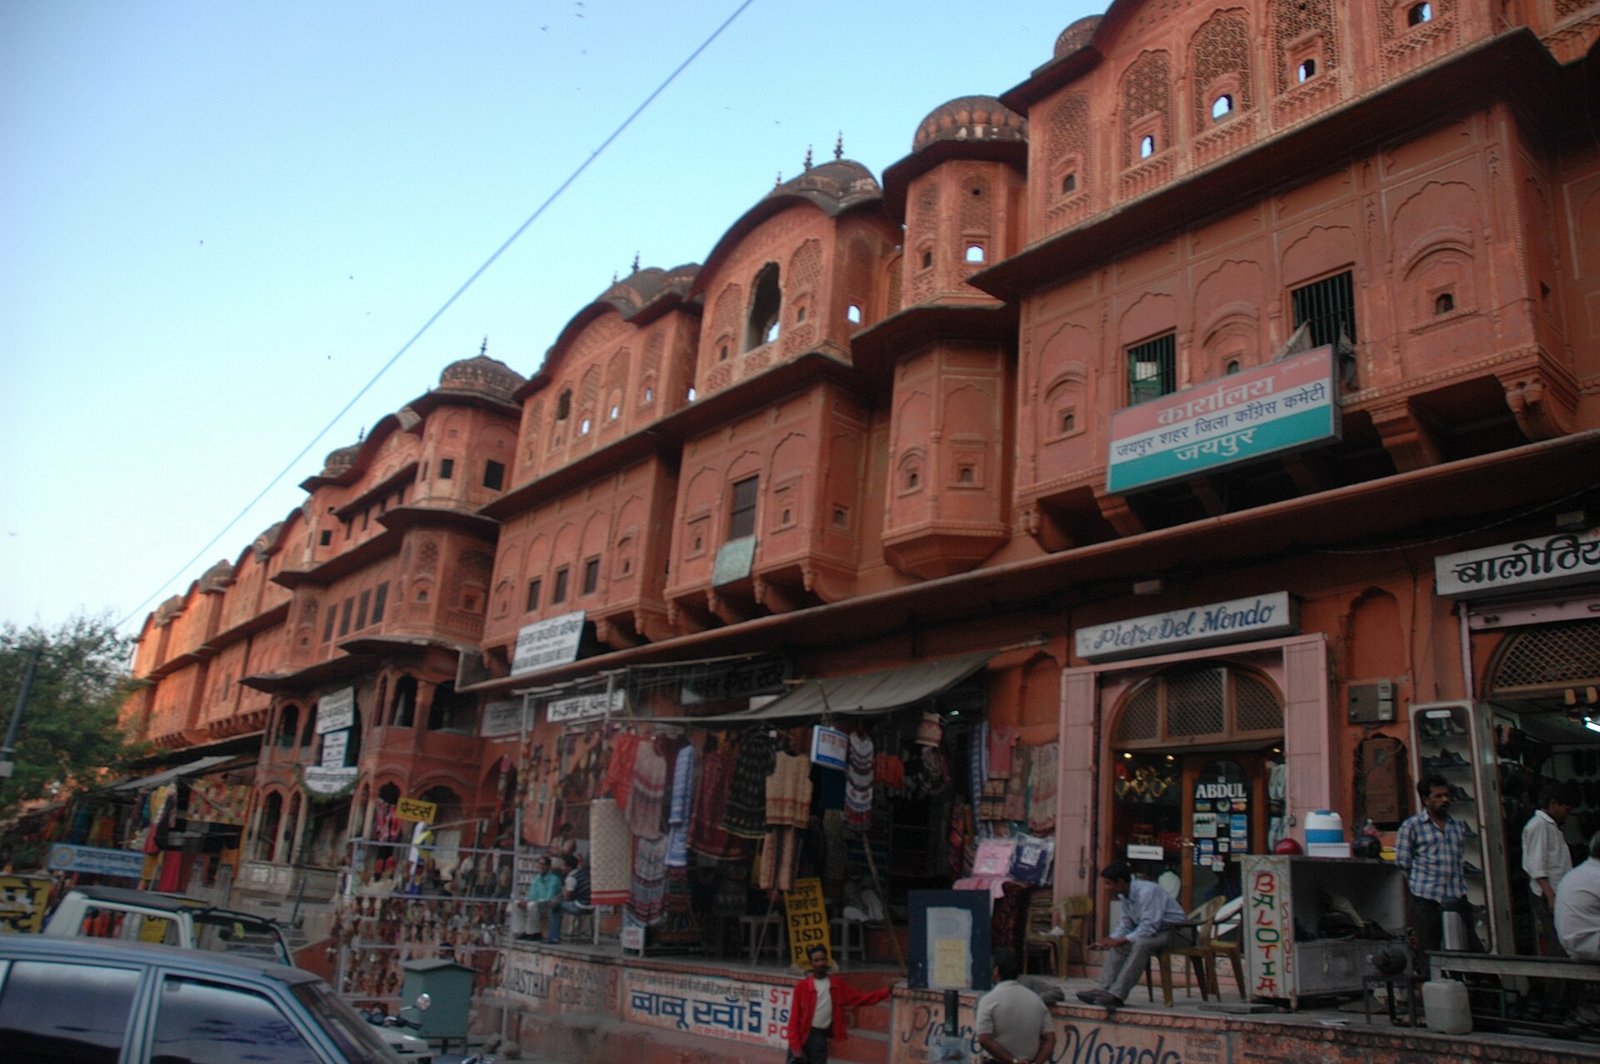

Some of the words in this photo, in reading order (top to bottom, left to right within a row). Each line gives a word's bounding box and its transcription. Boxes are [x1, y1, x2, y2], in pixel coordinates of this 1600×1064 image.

[1158, 376, 1275, 424] कार्यालय
[1116, 437, 1153, 457] जयपुर
[1160, 428, 1189, 445] शहर
[1195, 415, 1228, 435] जिला
[1284, 382, 1326, 410] कमेटी
[1174, 428, 1257, 461] जयपुर
[1200, 600, 1276, 633] Mondo
[1195, 783, 1247, 799] ABDUL
[791, 911, 822, 927] STD
[794, 927, 824, 943] ISD
[1252, 870, 1279, 993] BALOTIA
[749, 1001, 763, 1034] 5
